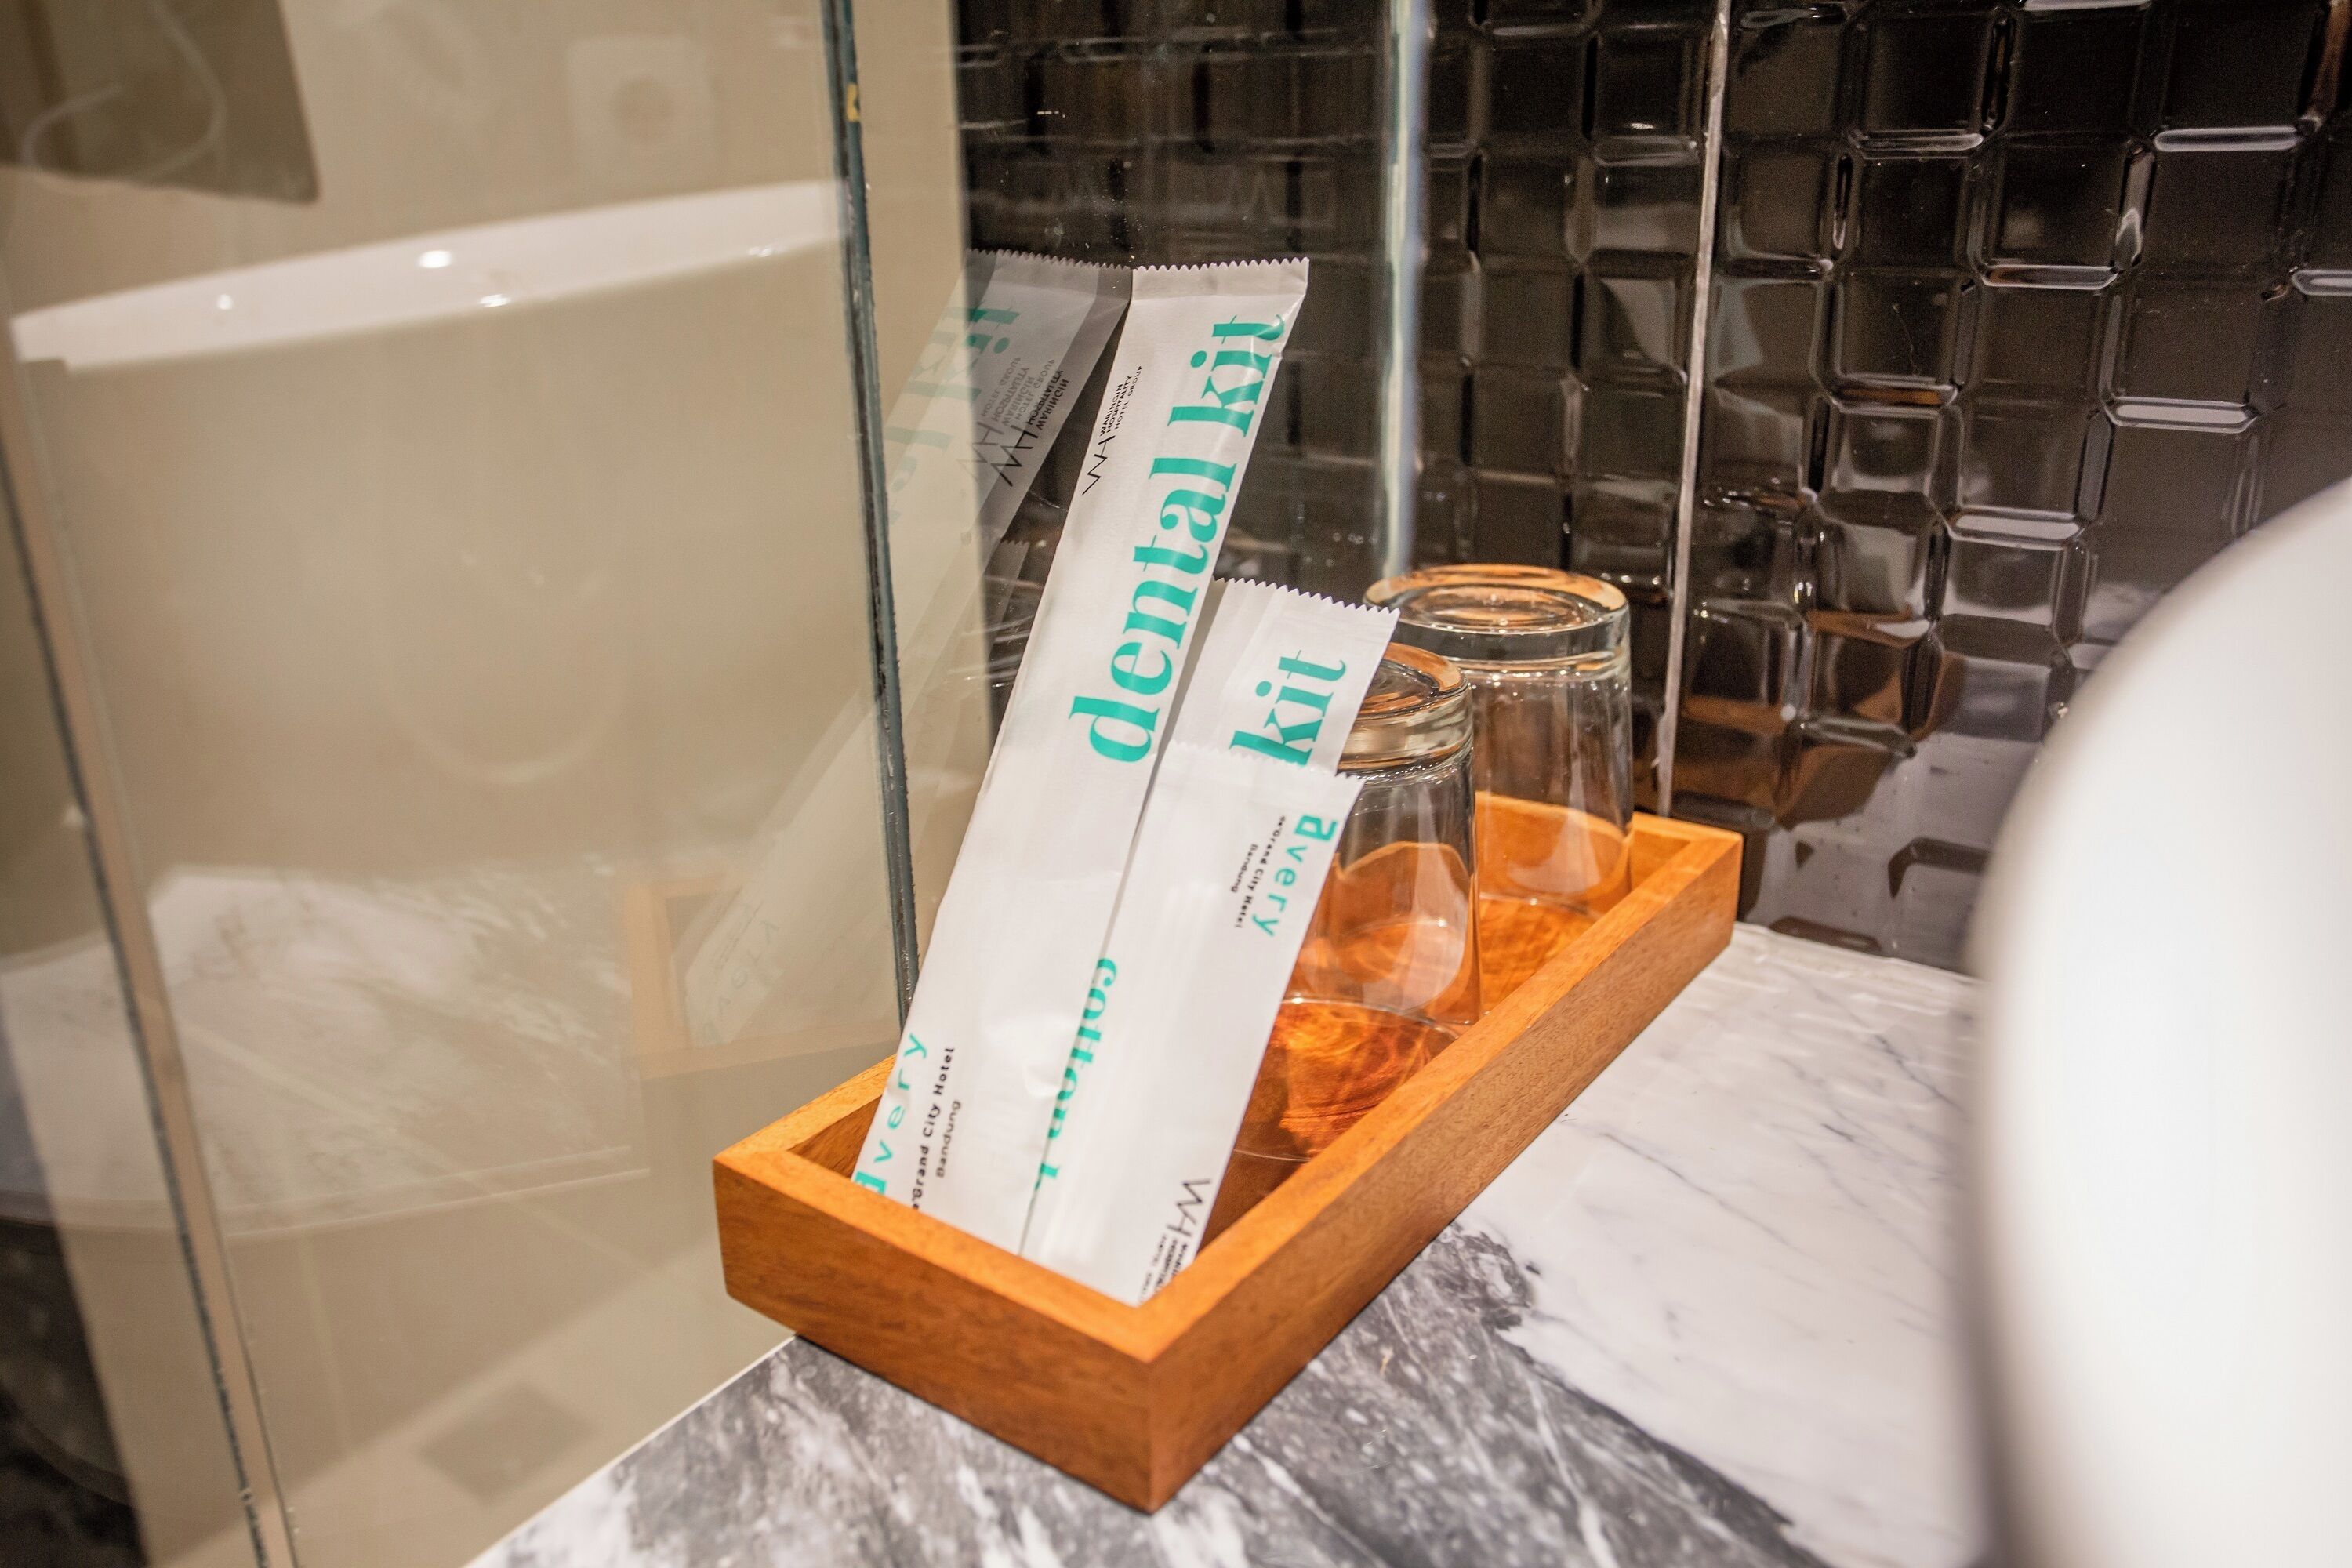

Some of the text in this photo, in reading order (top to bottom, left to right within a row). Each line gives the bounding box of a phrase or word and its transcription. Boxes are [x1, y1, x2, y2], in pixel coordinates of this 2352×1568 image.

[1100, 384, 1123, 437] WARINGIN
[1106, 376, 1132, 434] HOSPITALITY
[1115, 365, 1142, 430] HOTEL GROUP
[1069, 314, 1286, 762] dental kit
[1229, 650, 1347, 766] kit
[1247, 868, 1265, 891] City
[1252, 815, 1338, 936] avery
[922, 1102, 941, 1138] City
[932, 1047, 955, 1096] Hotel
[935, 1099, 962, 1178] Bandung
